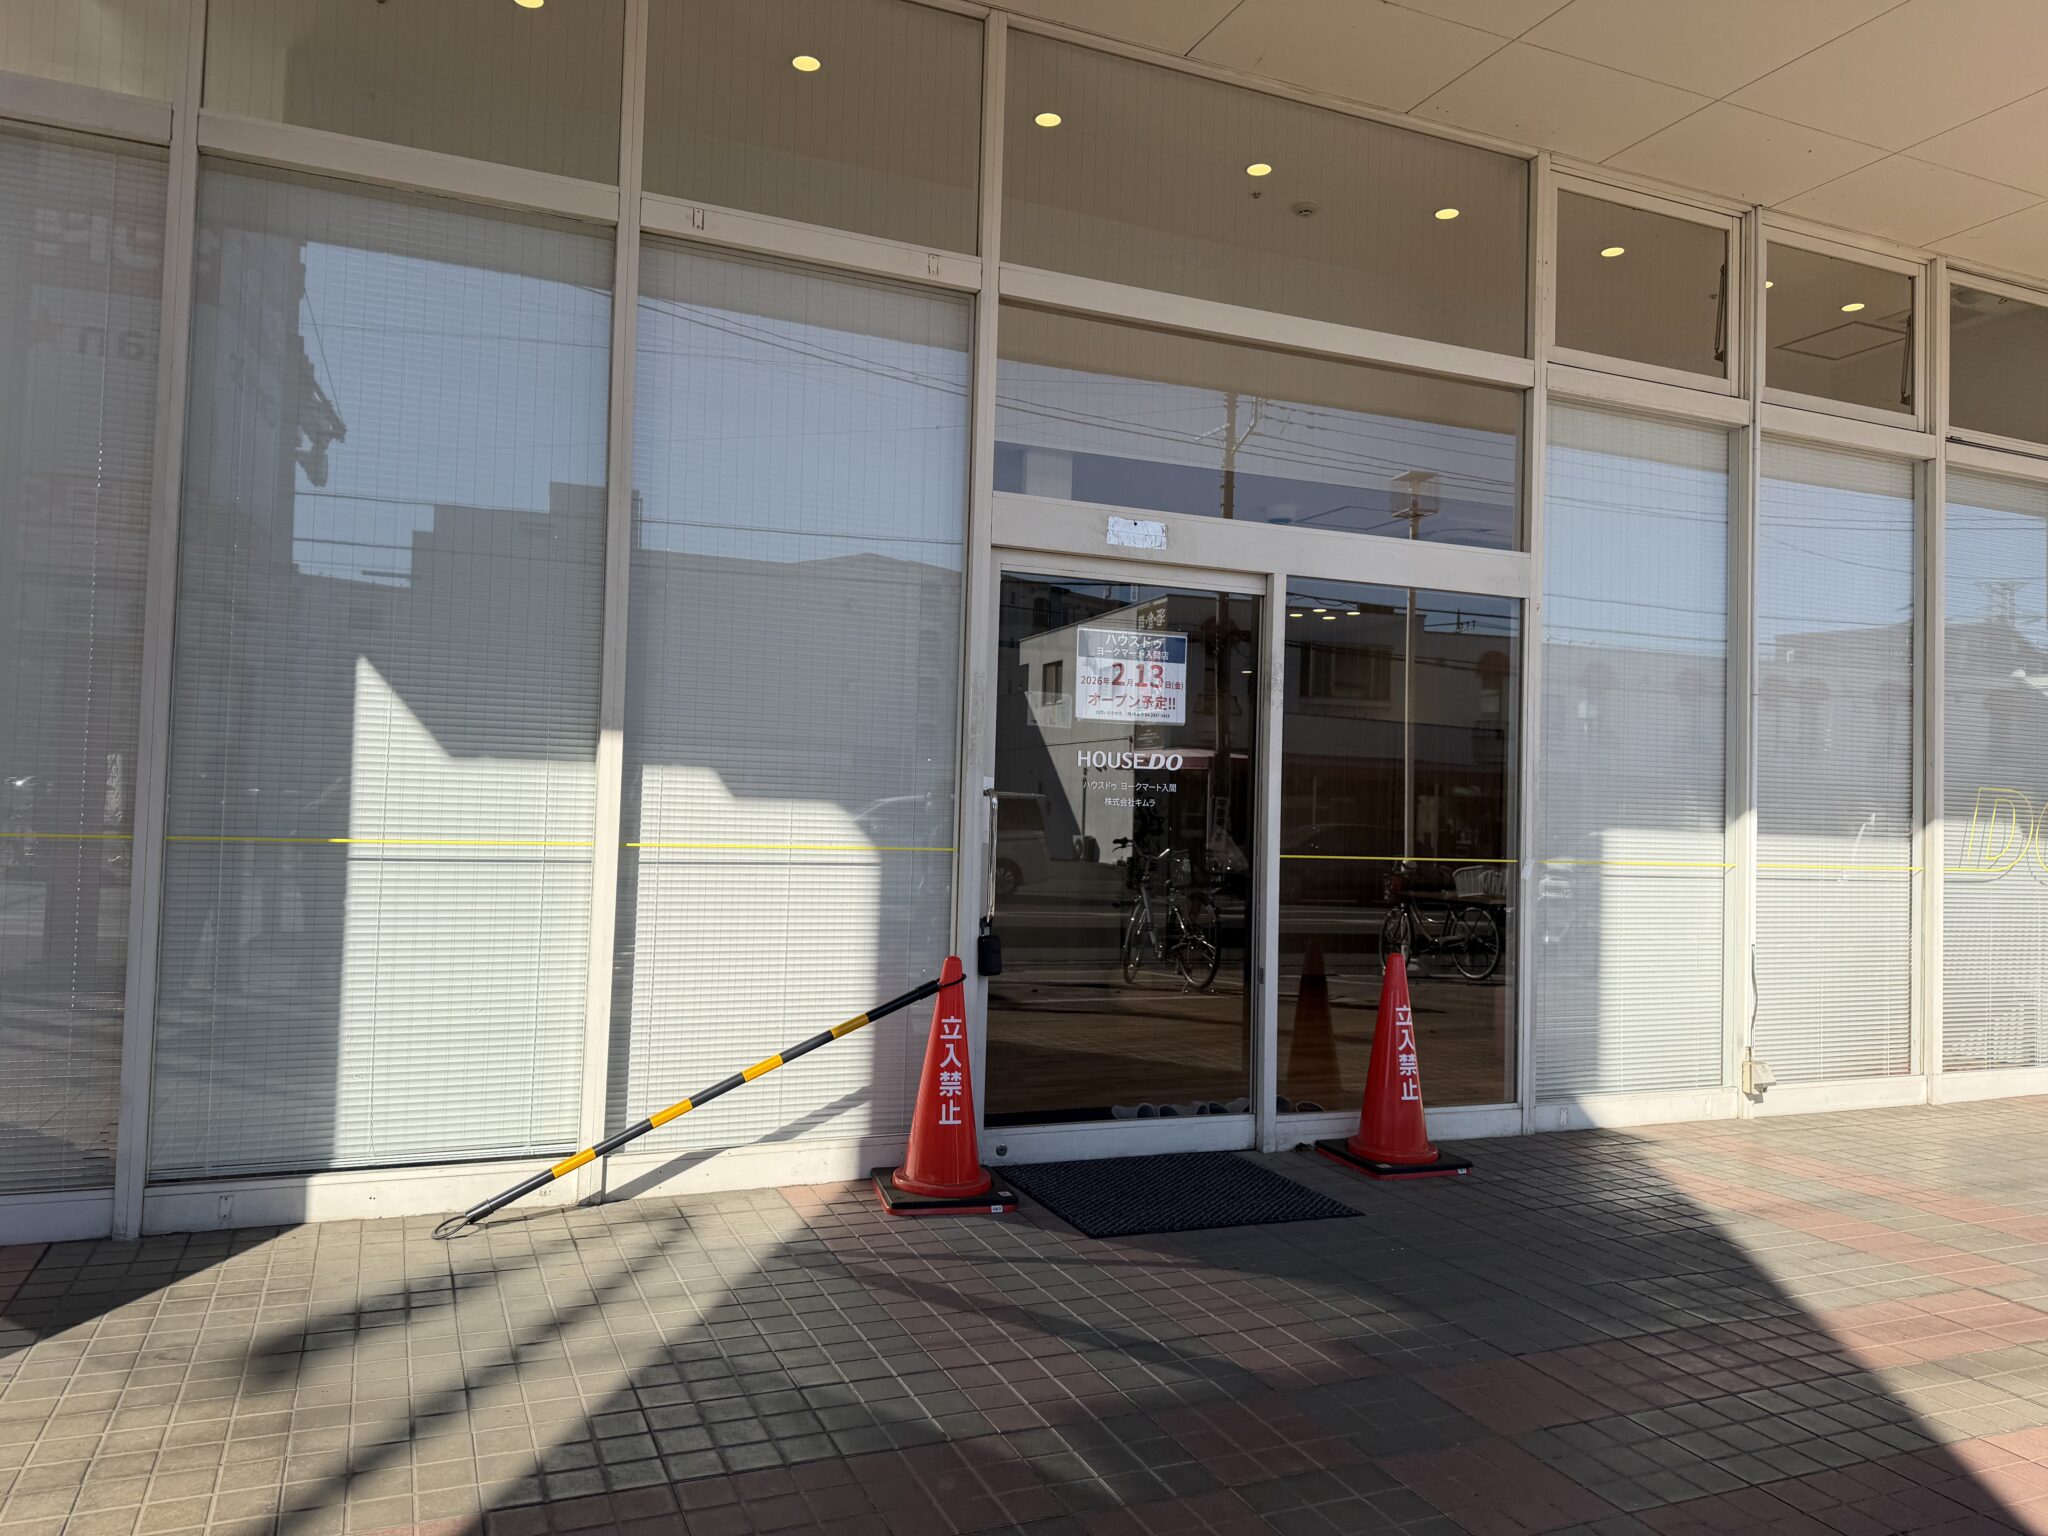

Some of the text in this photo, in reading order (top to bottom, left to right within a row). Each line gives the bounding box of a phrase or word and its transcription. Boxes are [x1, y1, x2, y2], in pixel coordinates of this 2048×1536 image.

[1105, 634, 1163, 650] ハウスドゥ
[1104, 797, 1157, 808] 株式会社キムラ
[939, 1016, 962, 1125] 立入禁止
[1395, 1004, 1419, 1101] 立入禁止
